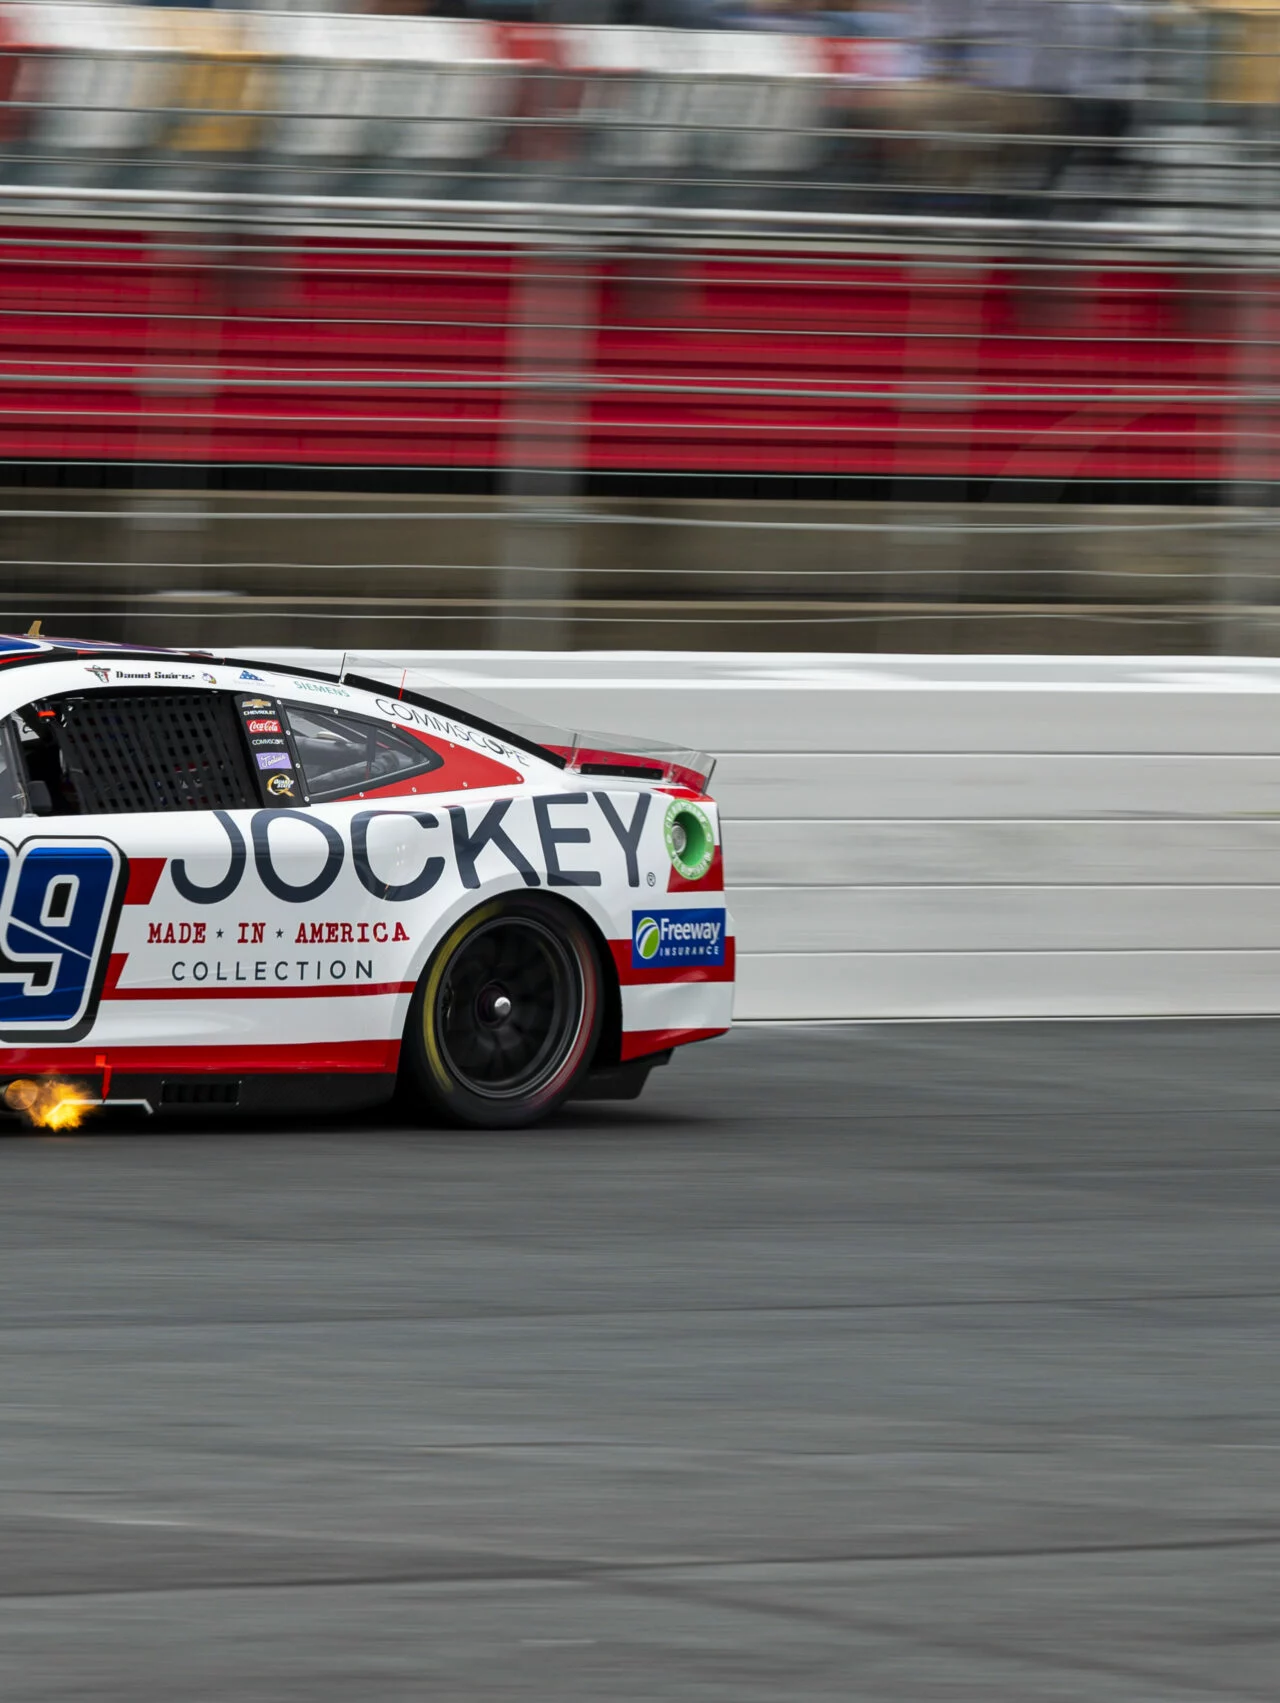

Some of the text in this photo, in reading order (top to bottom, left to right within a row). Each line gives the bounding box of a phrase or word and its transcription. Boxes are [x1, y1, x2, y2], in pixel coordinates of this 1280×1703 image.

[294, 680, 351, 697] SIEMENS
[249, 720, 279, 733] Coca-Cola
[375, 698, 530, 767] COMMSCOPE
[170, 791, 652, 905] JOCKEY
[147, 922, 411, 944] MADE IN AMERICA
[660, 918, 722, 945] Freeway
[659, 945, 720, 957] INSURANCE
[171, 959, 373, 981] COLLECTION
